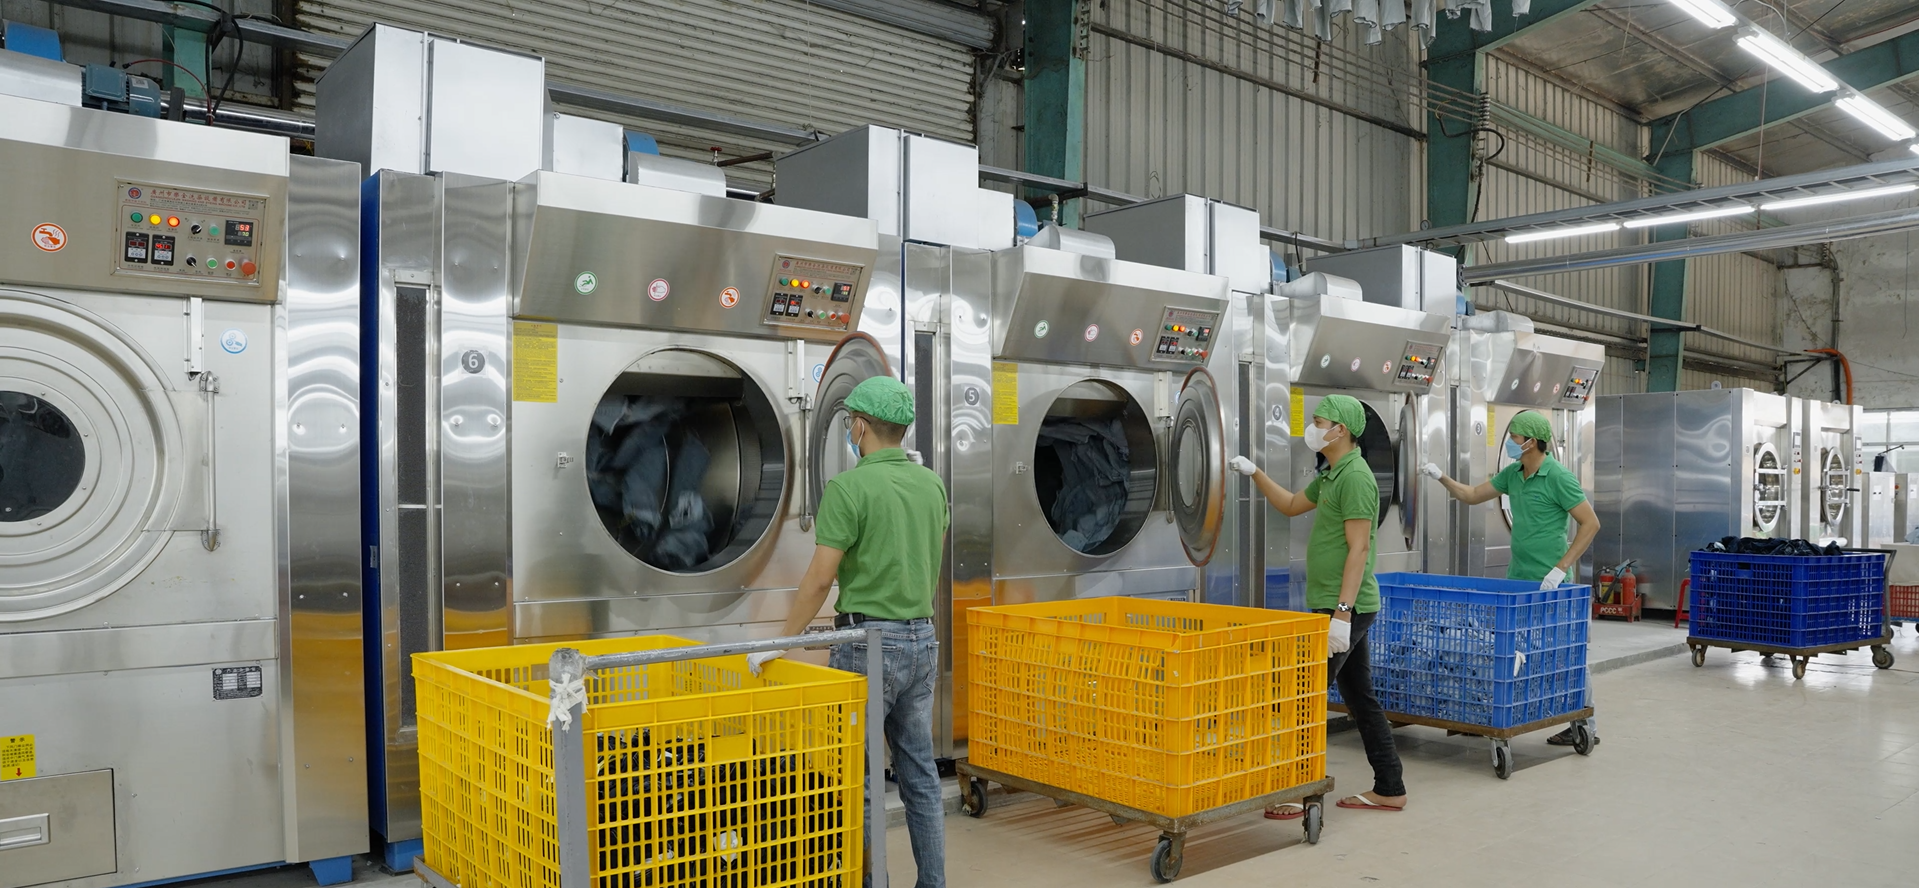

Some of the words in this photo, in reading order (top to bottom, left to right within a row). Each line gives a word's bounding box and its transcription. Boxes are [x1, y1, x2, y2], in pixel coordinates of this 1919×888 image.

[469, 353, 478, 368] 6
[969, 390, 975, 401] 5
[1275, 407, 1280, 417] 4
